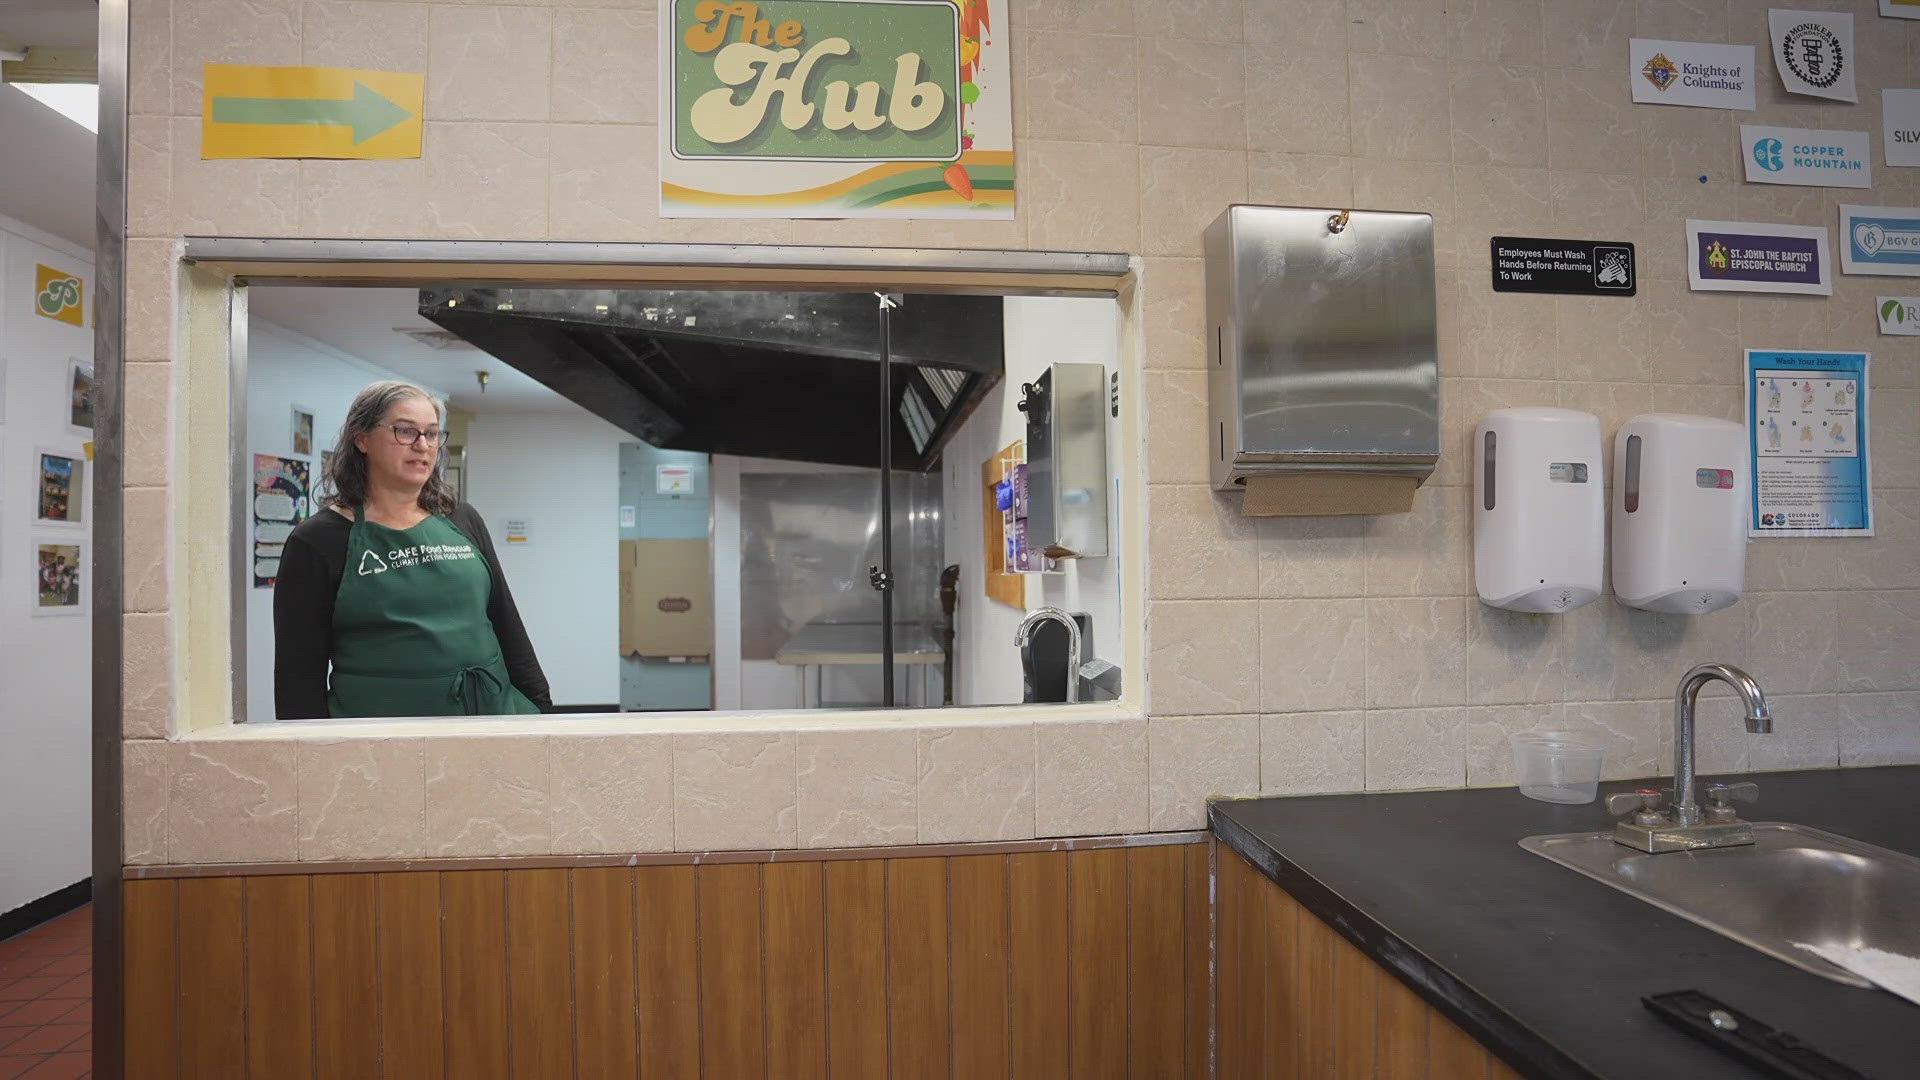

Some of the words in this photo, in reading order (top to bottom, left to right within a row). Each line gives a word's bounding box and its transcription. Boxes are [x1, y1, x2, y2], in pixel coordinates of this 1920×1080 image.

[684, 1, 804, 53] The
[1789, 23, 1833, 39] MONIKER
[1793, 30, 1830, 44] FOUNDATION
[1683, 63, 1728, 78] Knights
[1730, 66, 1741, 77] of
[1683, 75, 1742, 91] Columbus
[690, 37, 945, 144] Hub
[1793, 145, 1844, 156] COPPER
[1794, 157, 1861, 170] MOUNTAIN
[1887, 236, 1908, 246] BGV
[1499, 248, 1542, 258] Employees
[1543, 250, 1563, 259] Must
[1564, 250, 1586, 259] Wash
[1730, 249, 1742, 259] ST.
[1743, 249, 1765, 260] JOHN
[1766, 251, 1780, 260] THE
[1781, 252, 1813, 263] BAPTIST
[1499, 260, 1524, 269] Hands
[1526, 261, 1552, 269] Before
[1554, 262, 1592, 273] Returning
[1731, 260, 1774, 271] EPISCOPAL
[1775, 262, 1807, 273] CHURCH
[1500, 271, 1510, 280] To
[1511, 272, 1532, 281] Work
[1775, 357, 1796, 365] Wash
[1798, 357, 1815, 366] Your
[1816, 358, 1841, 366] Hands
[388, 547, 418, 560] CAFE
[391, 559, 419, 569] CLIMATE
